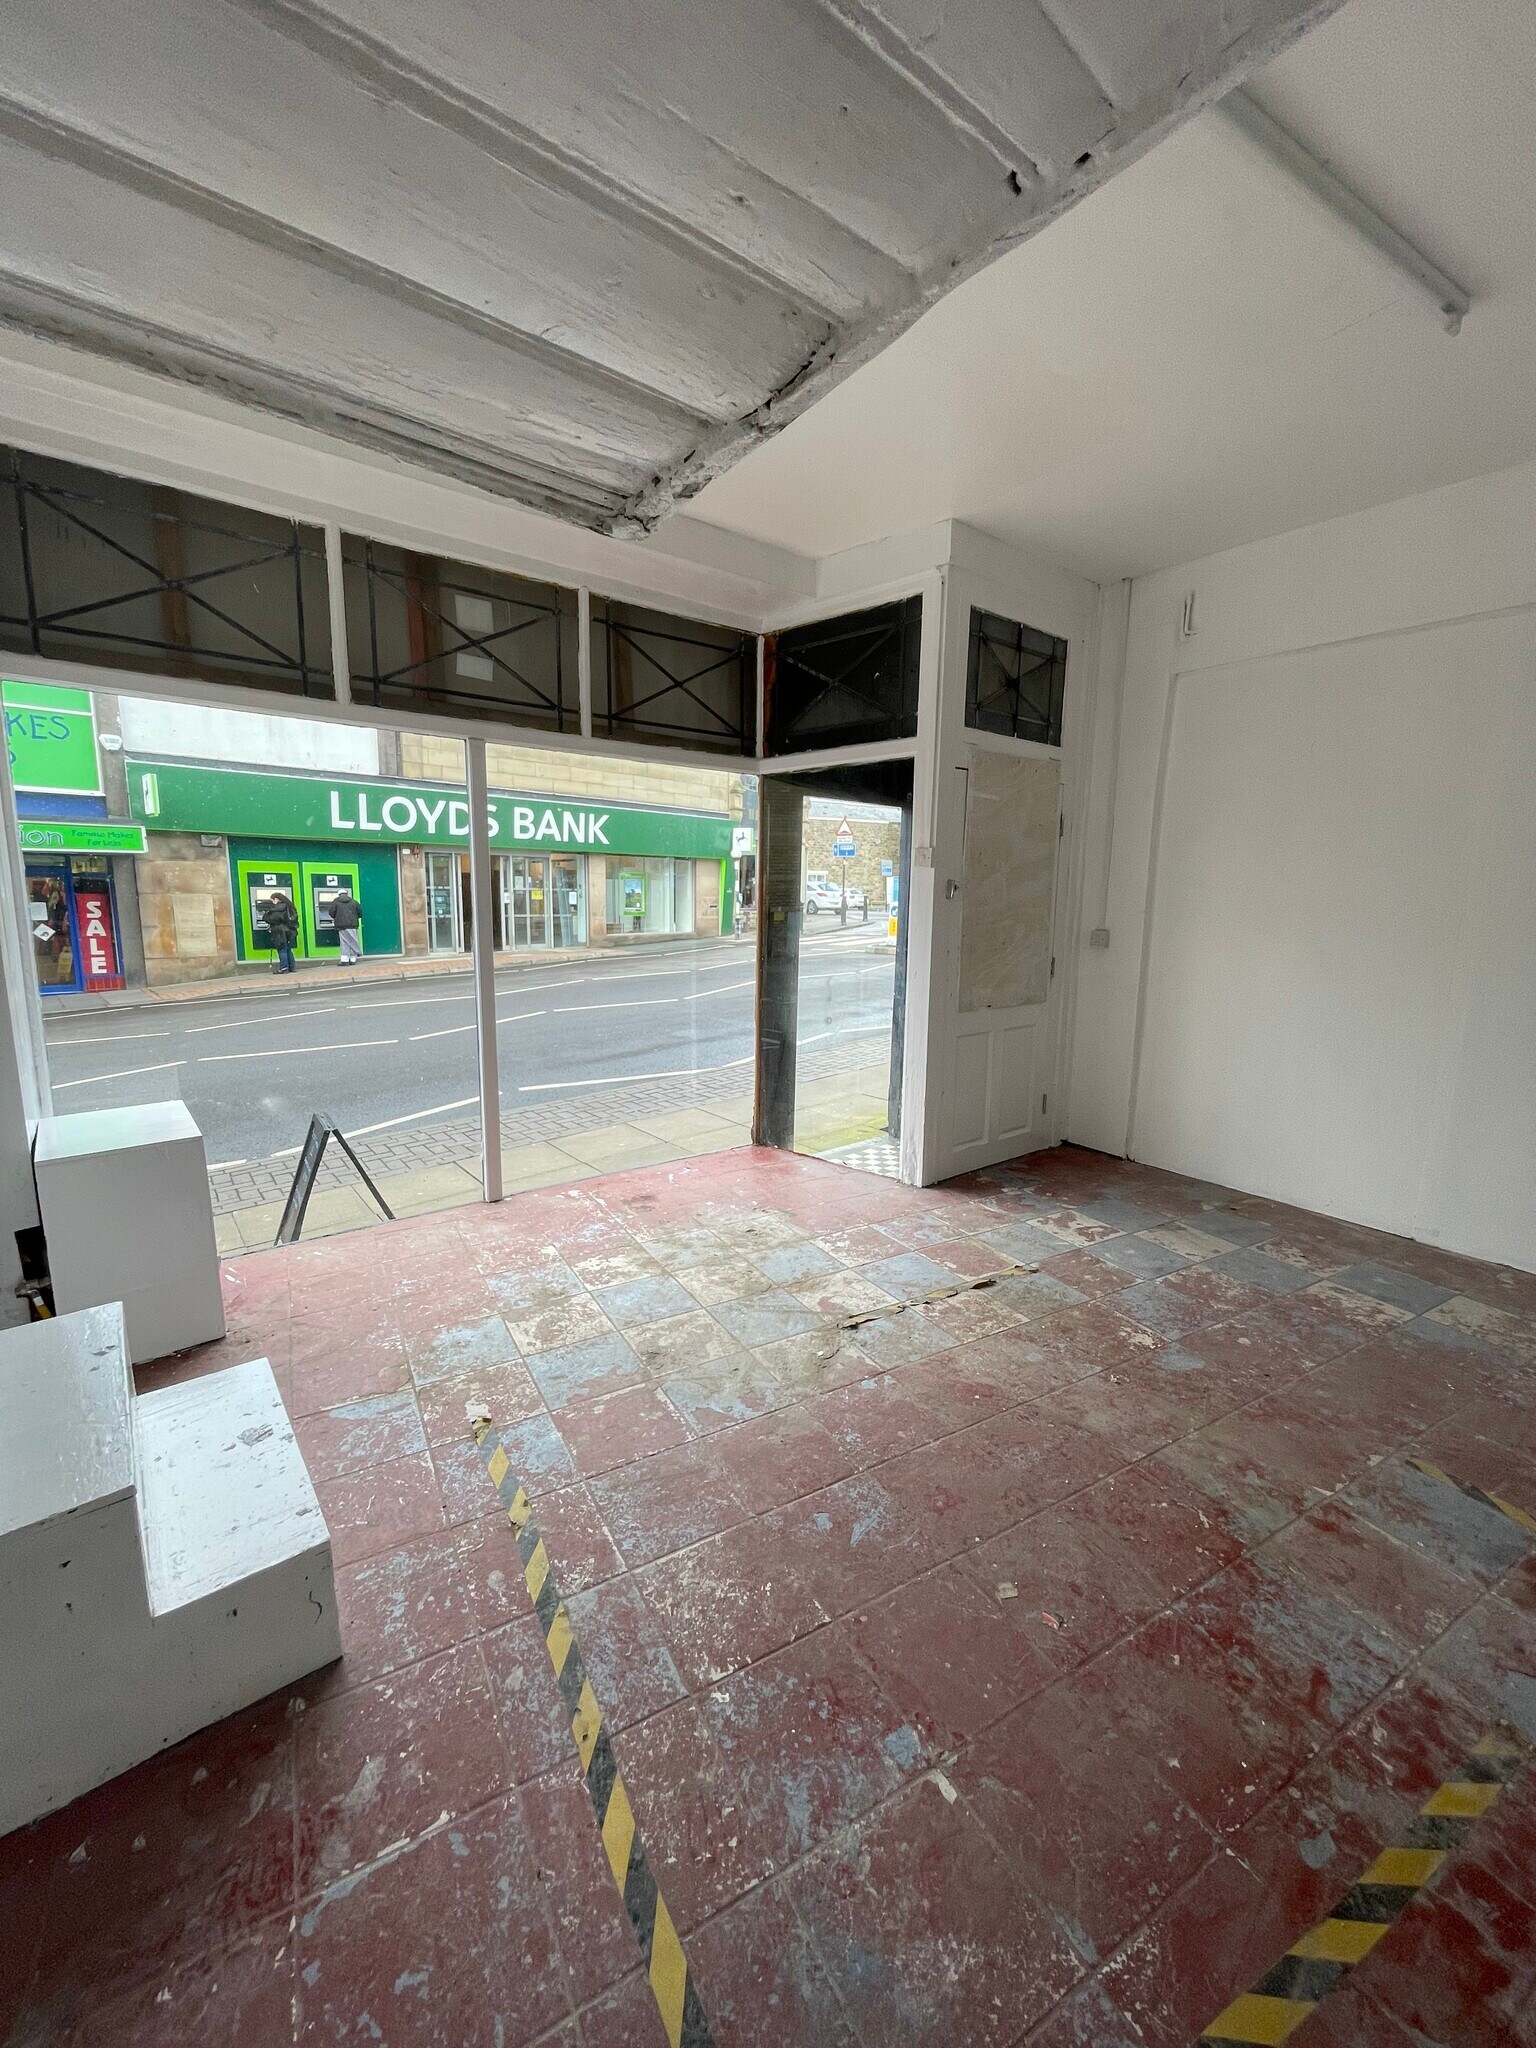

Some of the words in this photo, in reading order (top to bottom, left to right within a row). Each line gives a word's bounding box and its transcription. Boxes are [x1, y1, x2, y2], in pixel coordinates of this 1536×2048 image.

[103, 839, 122, 847] Less
[329, 790, 500, 838] LLOYDS
[513, 806, 611, 845] BANK
[86, 901, 107, 974] SALE
